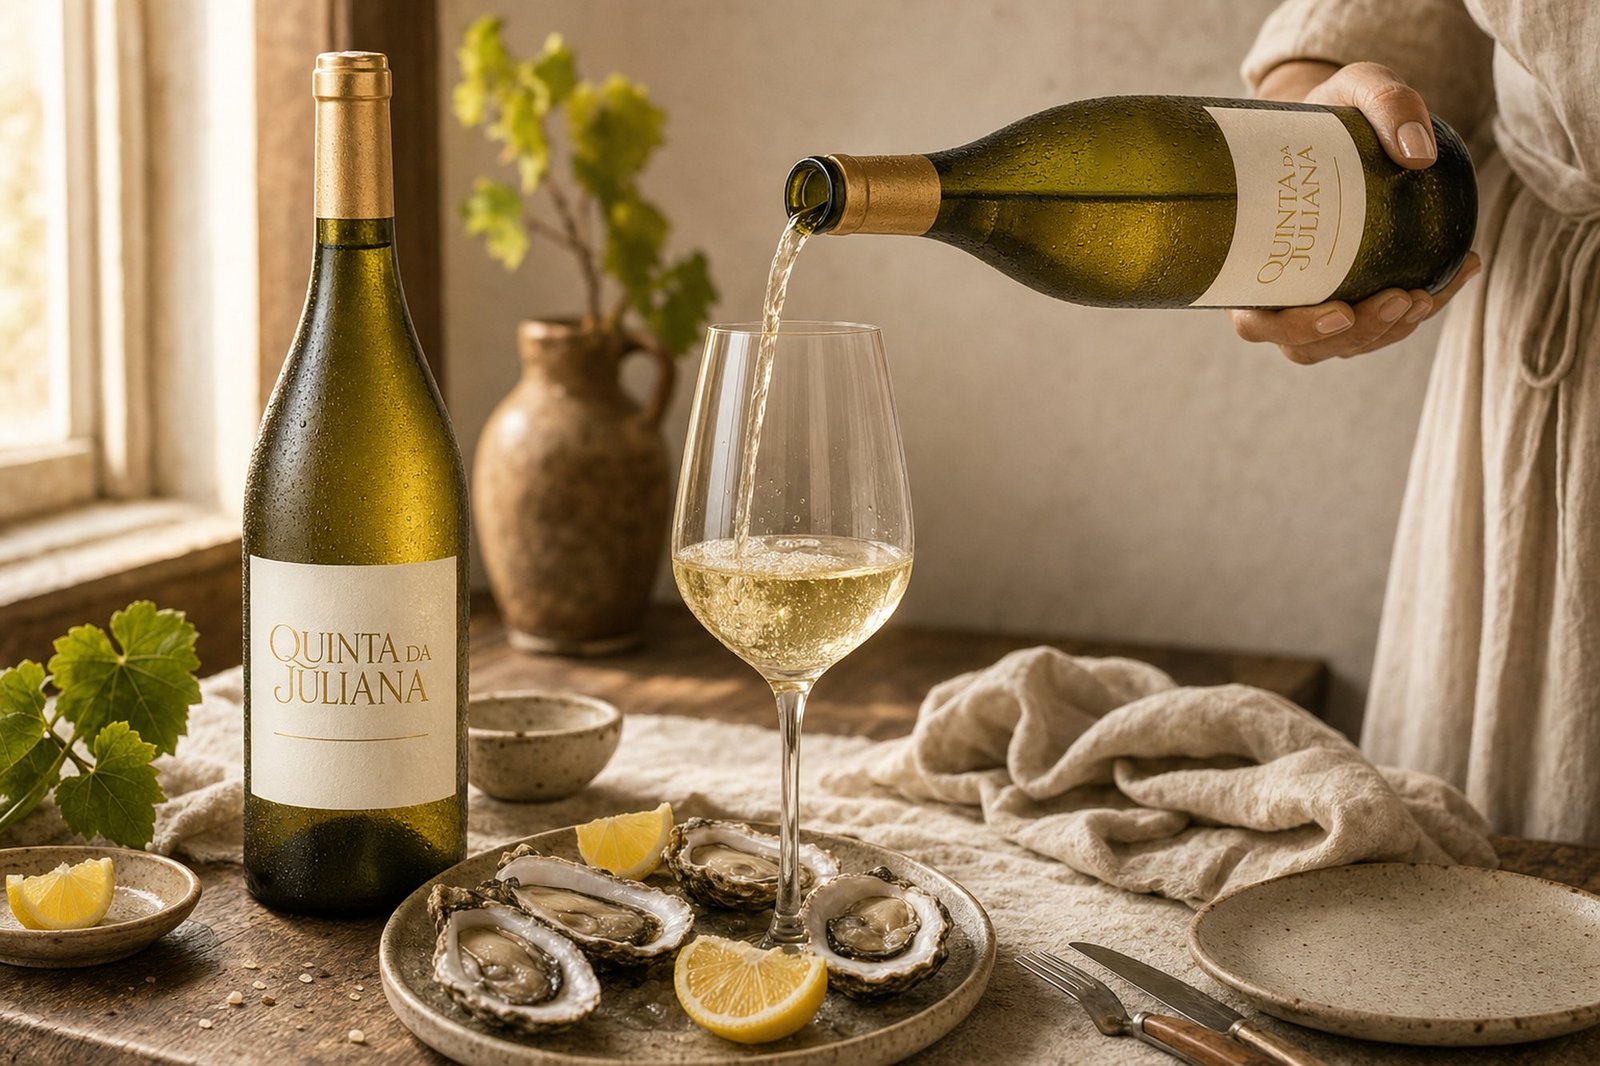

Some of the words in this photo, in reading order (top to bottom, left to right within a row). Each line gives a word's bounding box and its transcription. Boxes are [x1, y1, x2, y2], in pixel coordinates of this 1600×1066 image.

[1256, 171, 1298, 284] QUINTA
[1280, 145, 1294, 168] DA
[1292, 145, 1321, 271] JULIANA
[269, 623, 400, 669] QUINTA
[406, 644, 432, 663] DA
[273, 664, 429, 705] JULIANA
